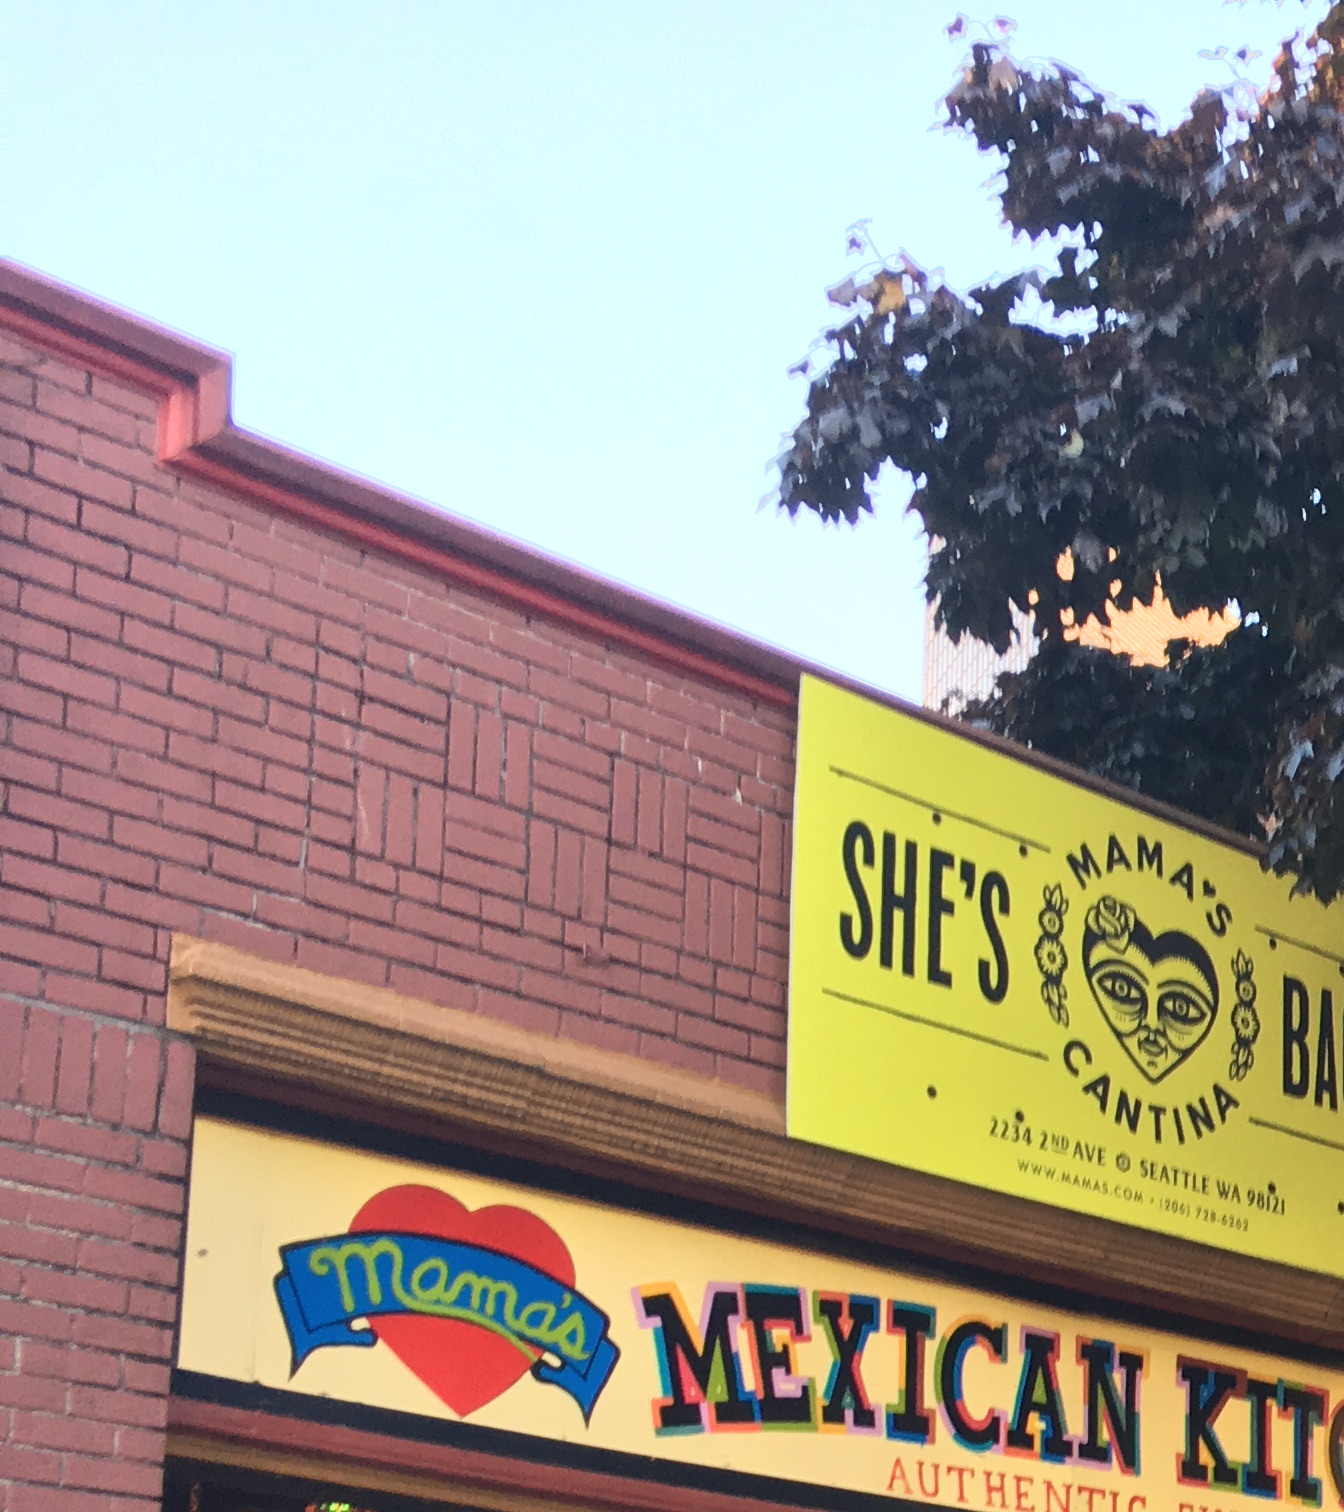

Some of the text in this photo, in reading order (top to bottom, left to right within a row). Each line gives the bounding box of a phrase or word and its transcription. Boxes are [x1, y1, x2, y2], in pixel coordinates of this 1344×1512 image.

[839, 820, 1011, 1005] SHE'S
[1066, 834, 1233, 936] MAMA'S
[1062, 1038, 1240, 1146] CANTINA
[989, 1114, 1287, 1216] 2234 2ND AVE SEATTLE WA 98121
[308, 1236, 592, 1361] Mama's
[631, 1281, 1150, 1478] MEXICAN
